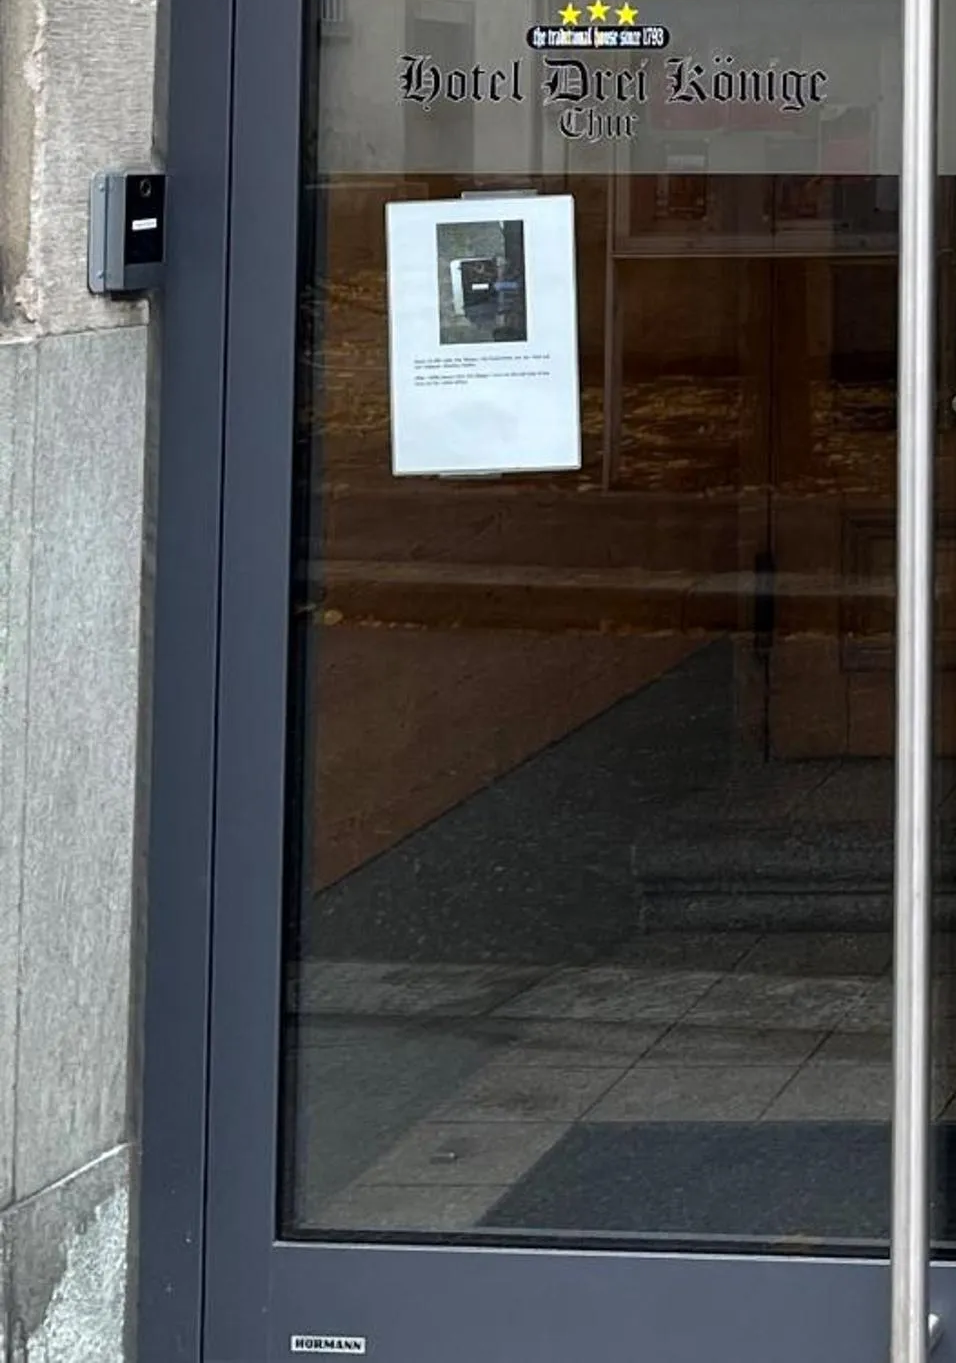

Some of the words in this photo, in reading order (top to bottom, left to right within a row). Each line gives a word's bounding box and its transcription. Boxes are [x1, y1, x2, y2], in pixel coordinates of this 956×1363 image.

[533, 26, 545, 48] the
[594, 27, 618, 48] house
[400, 54, 525, 112] Hotel
[543, 57, 648, 105] Drei
[667, 56, 828, 111] Könige
[558, 107, 639, 141] Chur
